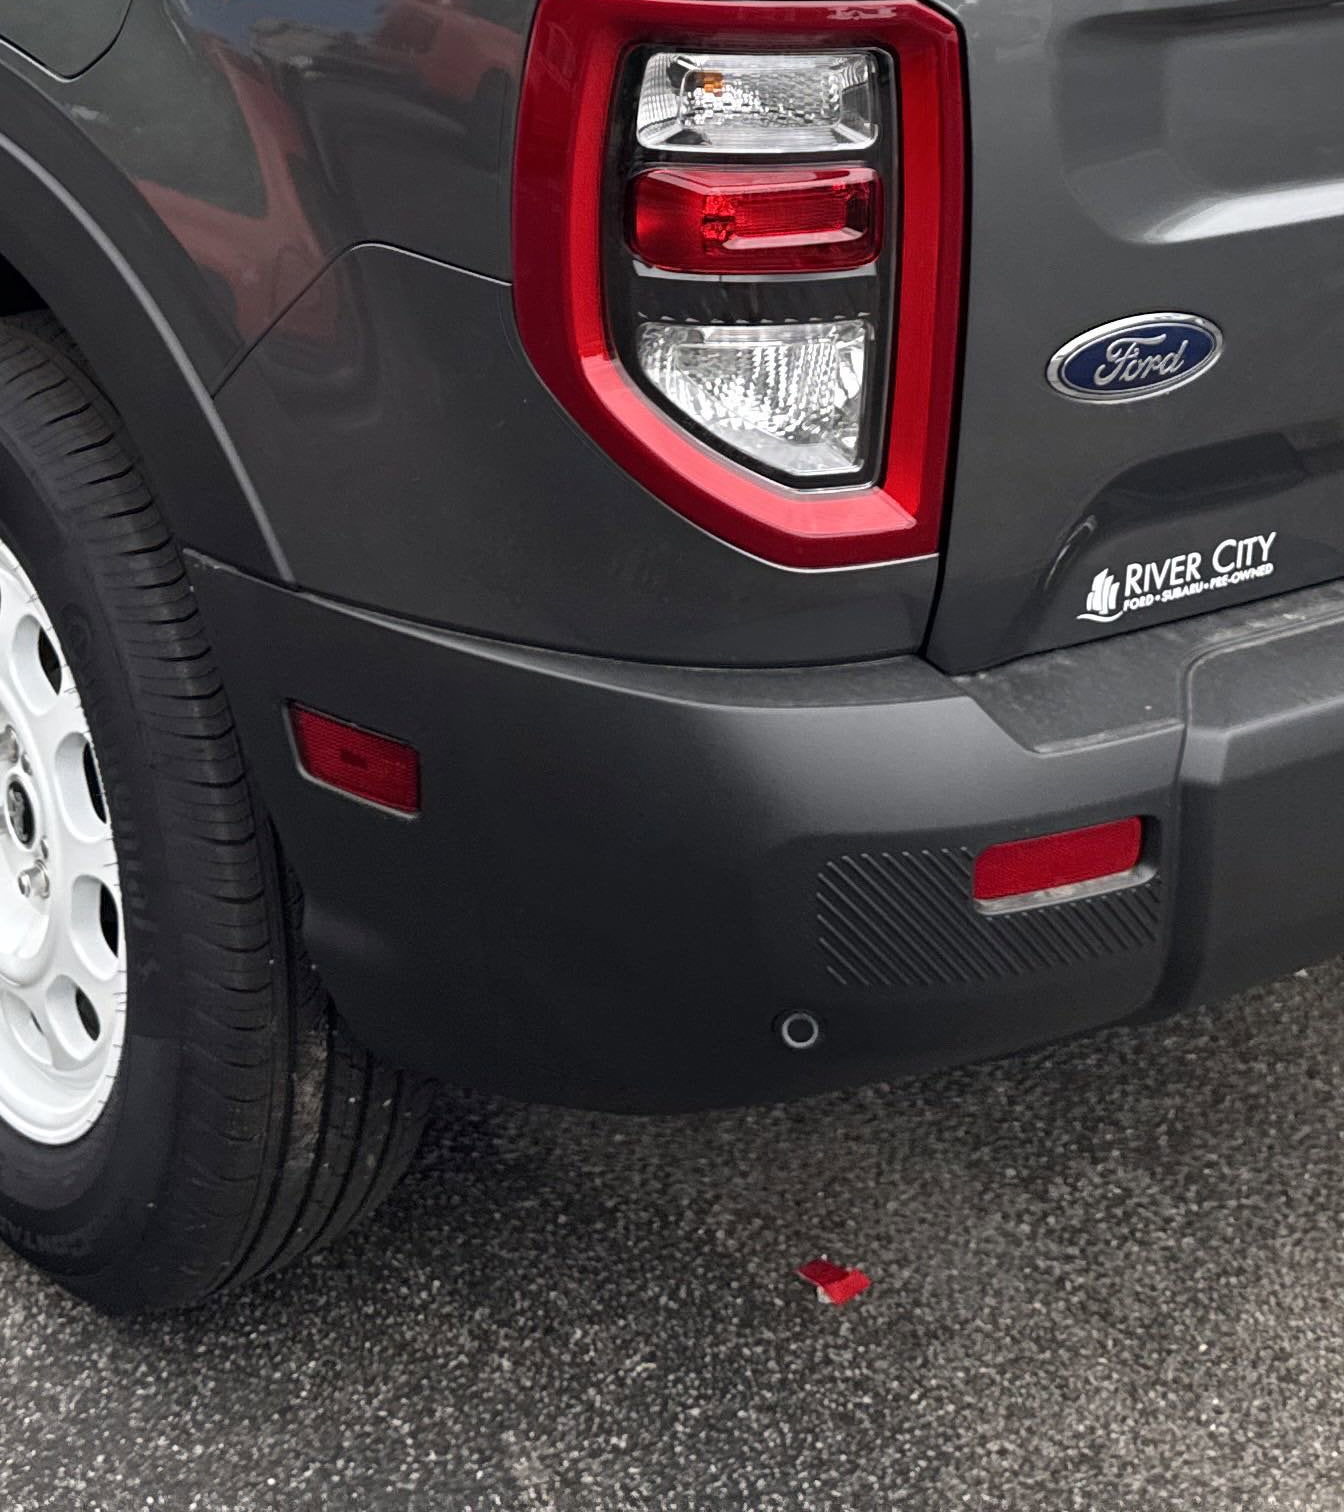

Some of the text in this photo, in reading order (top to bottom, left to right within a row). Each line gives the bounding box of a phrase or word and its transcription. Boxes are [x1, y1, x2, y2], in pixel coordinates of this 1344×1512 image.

[1094, 333, 1189, 386] Ford
[1123, 562, 1275, 611] FORD SUBARU PRE-OWNED
[1124, 531, 1277, 597] RIVER CITY
